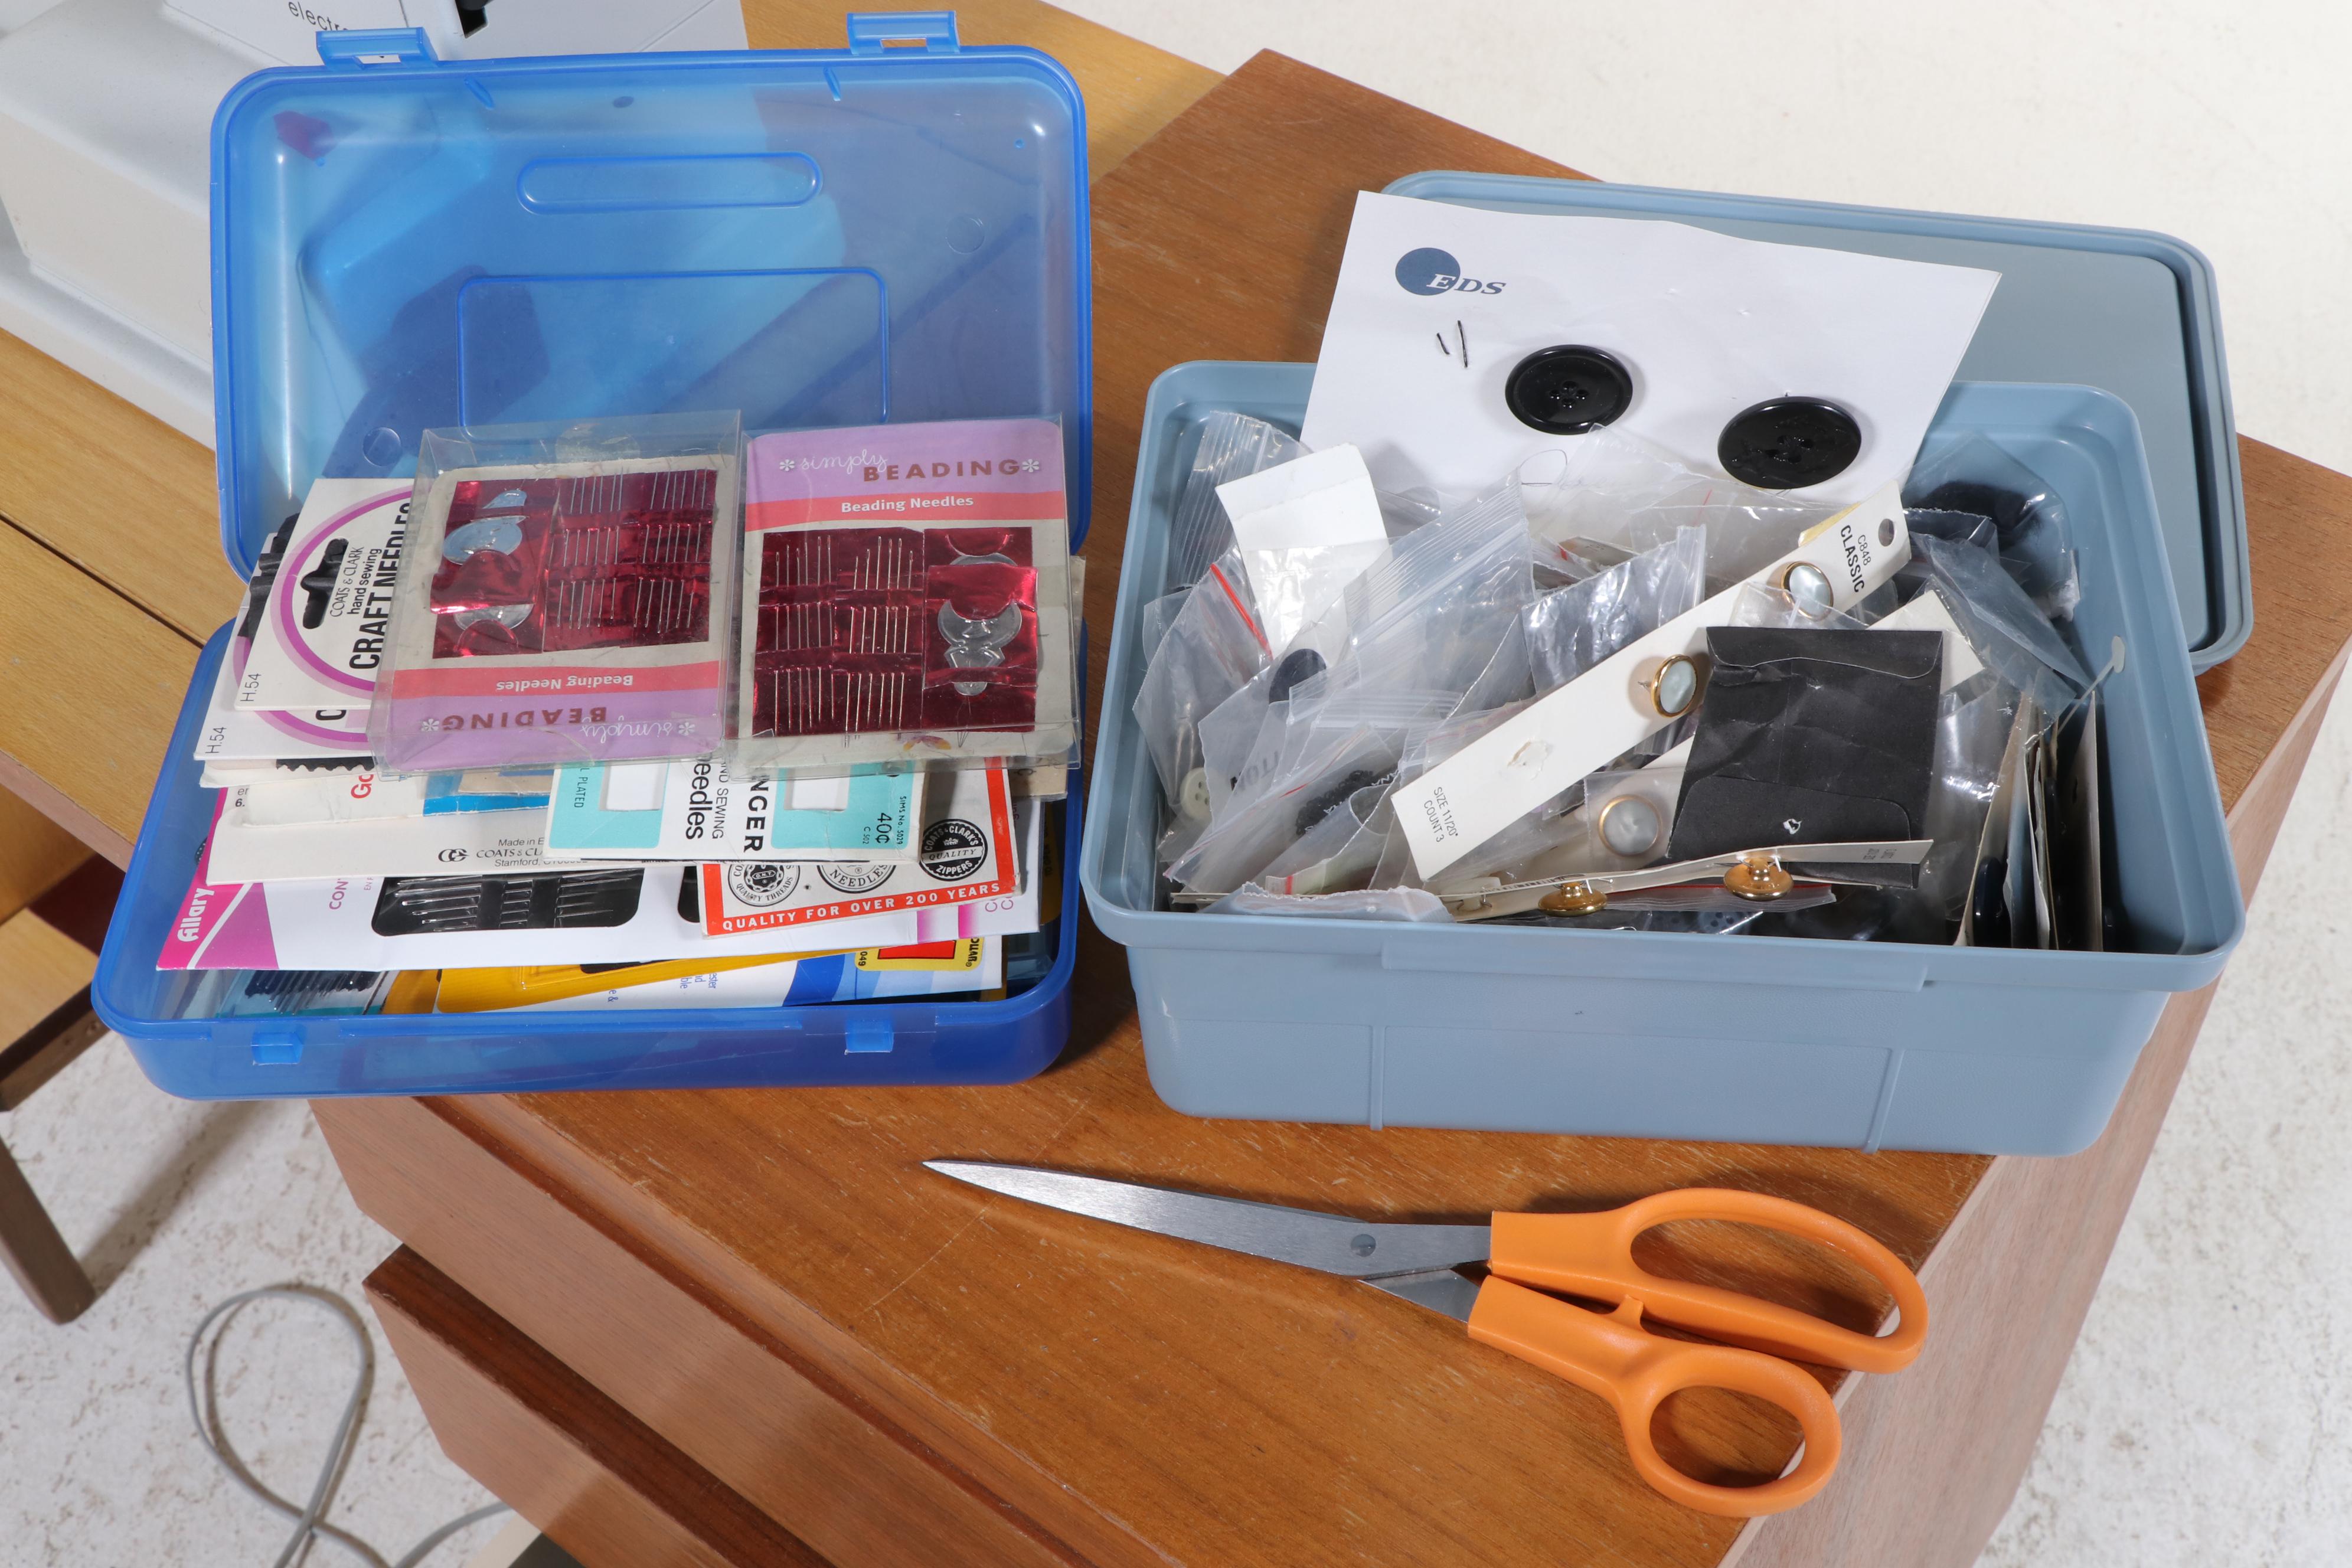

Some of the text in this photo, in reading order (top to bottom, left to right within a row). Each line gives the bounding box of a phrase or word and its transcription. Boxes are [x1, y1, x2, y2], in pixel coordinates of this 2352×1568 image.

[288, 1, 349, 30] electr
[1426, 273, 1507, 295] EDS
[801, 449, 1020, 482] simply BEADING
[841, 495, 974, 513] Beading Needles
[1841, 525, 1864, 593] CLASSIC
[1858, 534, 1871, 566] C848
[330, 587, 350, 617] COATS
[344, 547, 364, 576] CLARK
[347, 548, 382, 615] hand sewing
[349, 592, 392, 669] CRAFT
[240, 673, 262, 702] H.54
[496, 674, 633, 691] Beading Needles
[442, 707, 672, 744] simply BEADING
[205, 727, 227, 754] H.54
[574, 776, 589, 808] PLATED
[899, 796, 907, 813] SIMS
[1433, 786, 1448, 809] SIZE
[711, 788, 729, 839] SEWING
[1423, 800, 1445, 842] COUNT 3
[896, 830, 904, 845] 5029
[925, 828, 944, 851] COATS
[949, 825, 979, 845] CLARK'S
[476, 848, 515, 858] COATS
[929, 849, 977, 861] QUALITY
[936, 860, 973, 874] ZIPPERS
[328, 878, 348, 910] CON
[765, 876, 793, 901] THREADS
[177, 888, 215, 942] Allary
[722, 883, 1000, 931] QUALITY FOR OVER 200 YEARS
